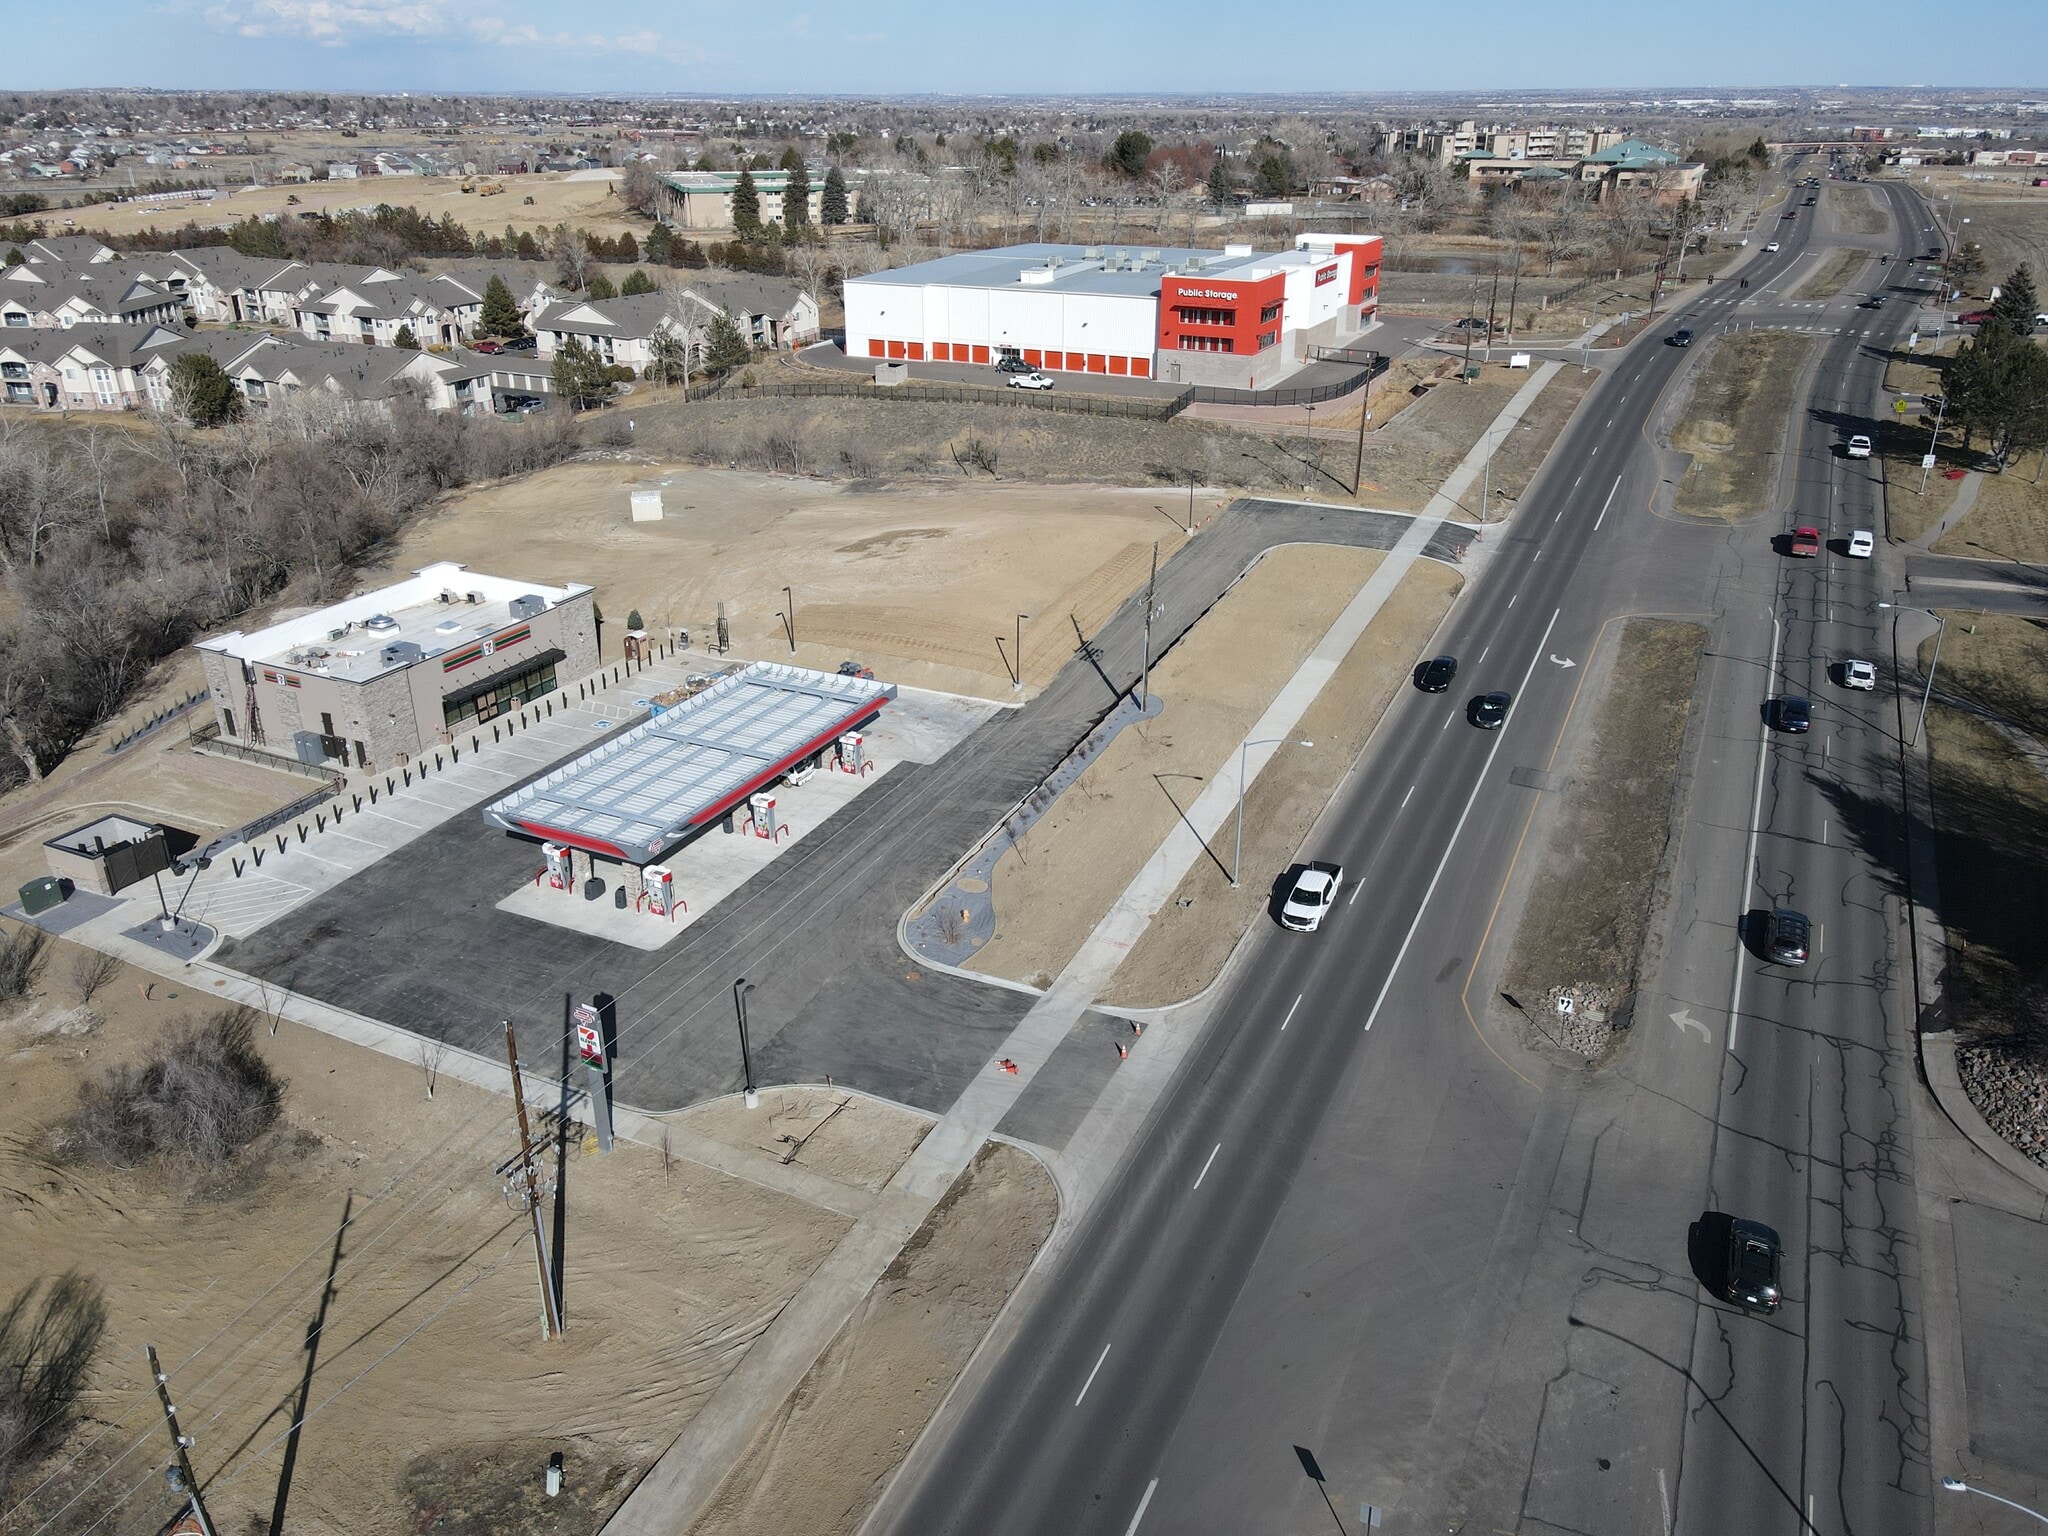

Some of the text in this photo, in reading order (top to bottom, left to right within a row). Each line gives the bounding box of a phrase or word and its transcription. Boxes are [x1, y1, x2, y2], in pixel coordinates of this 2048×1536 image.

[1177, 287, 1238, 301] Public Storage
[579, 1027, 595, 1052] 7
